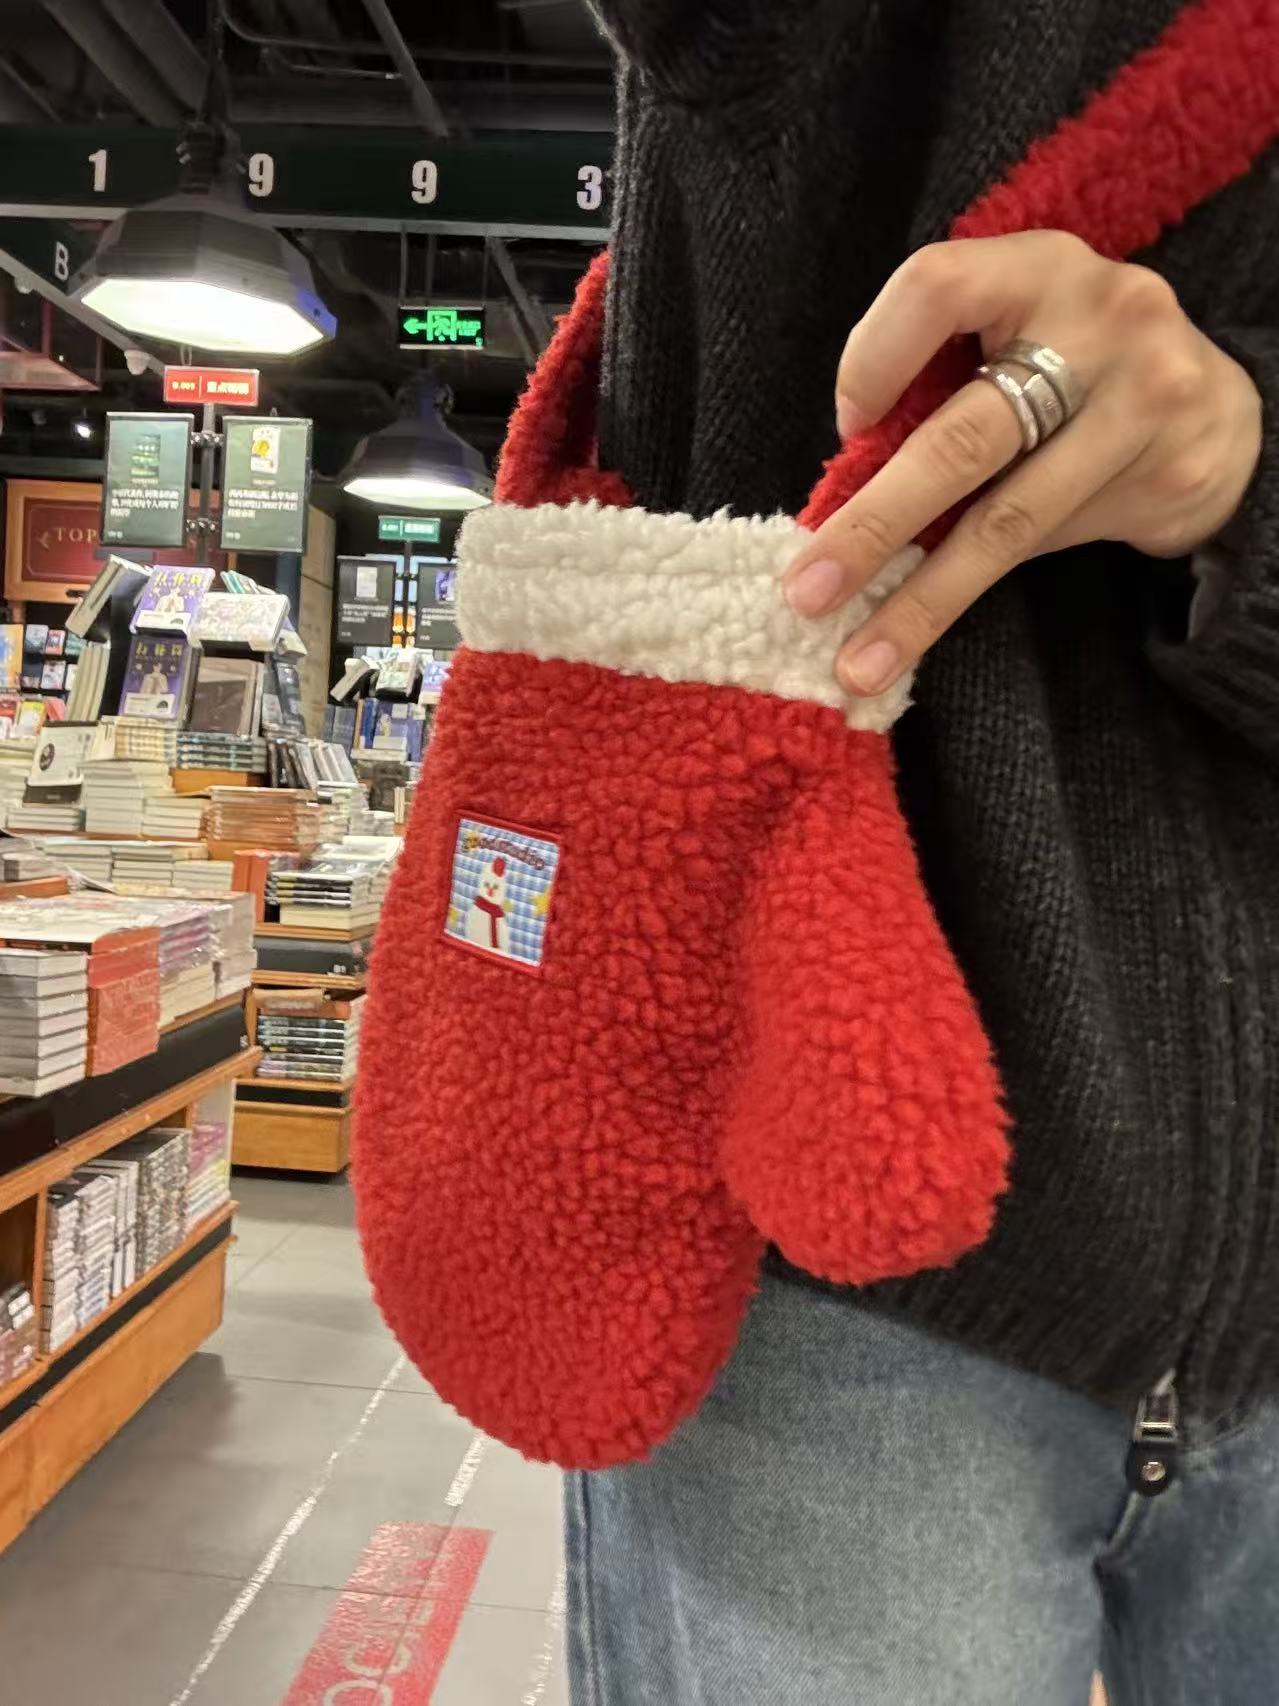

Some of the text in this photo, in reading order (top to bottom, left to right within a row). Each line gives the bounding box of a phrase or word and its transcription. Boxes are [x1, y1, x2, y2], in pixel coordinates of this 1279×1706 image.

[88, 149, 603, 210] 1 9 9 3
[54, 241, 69, 282] B
